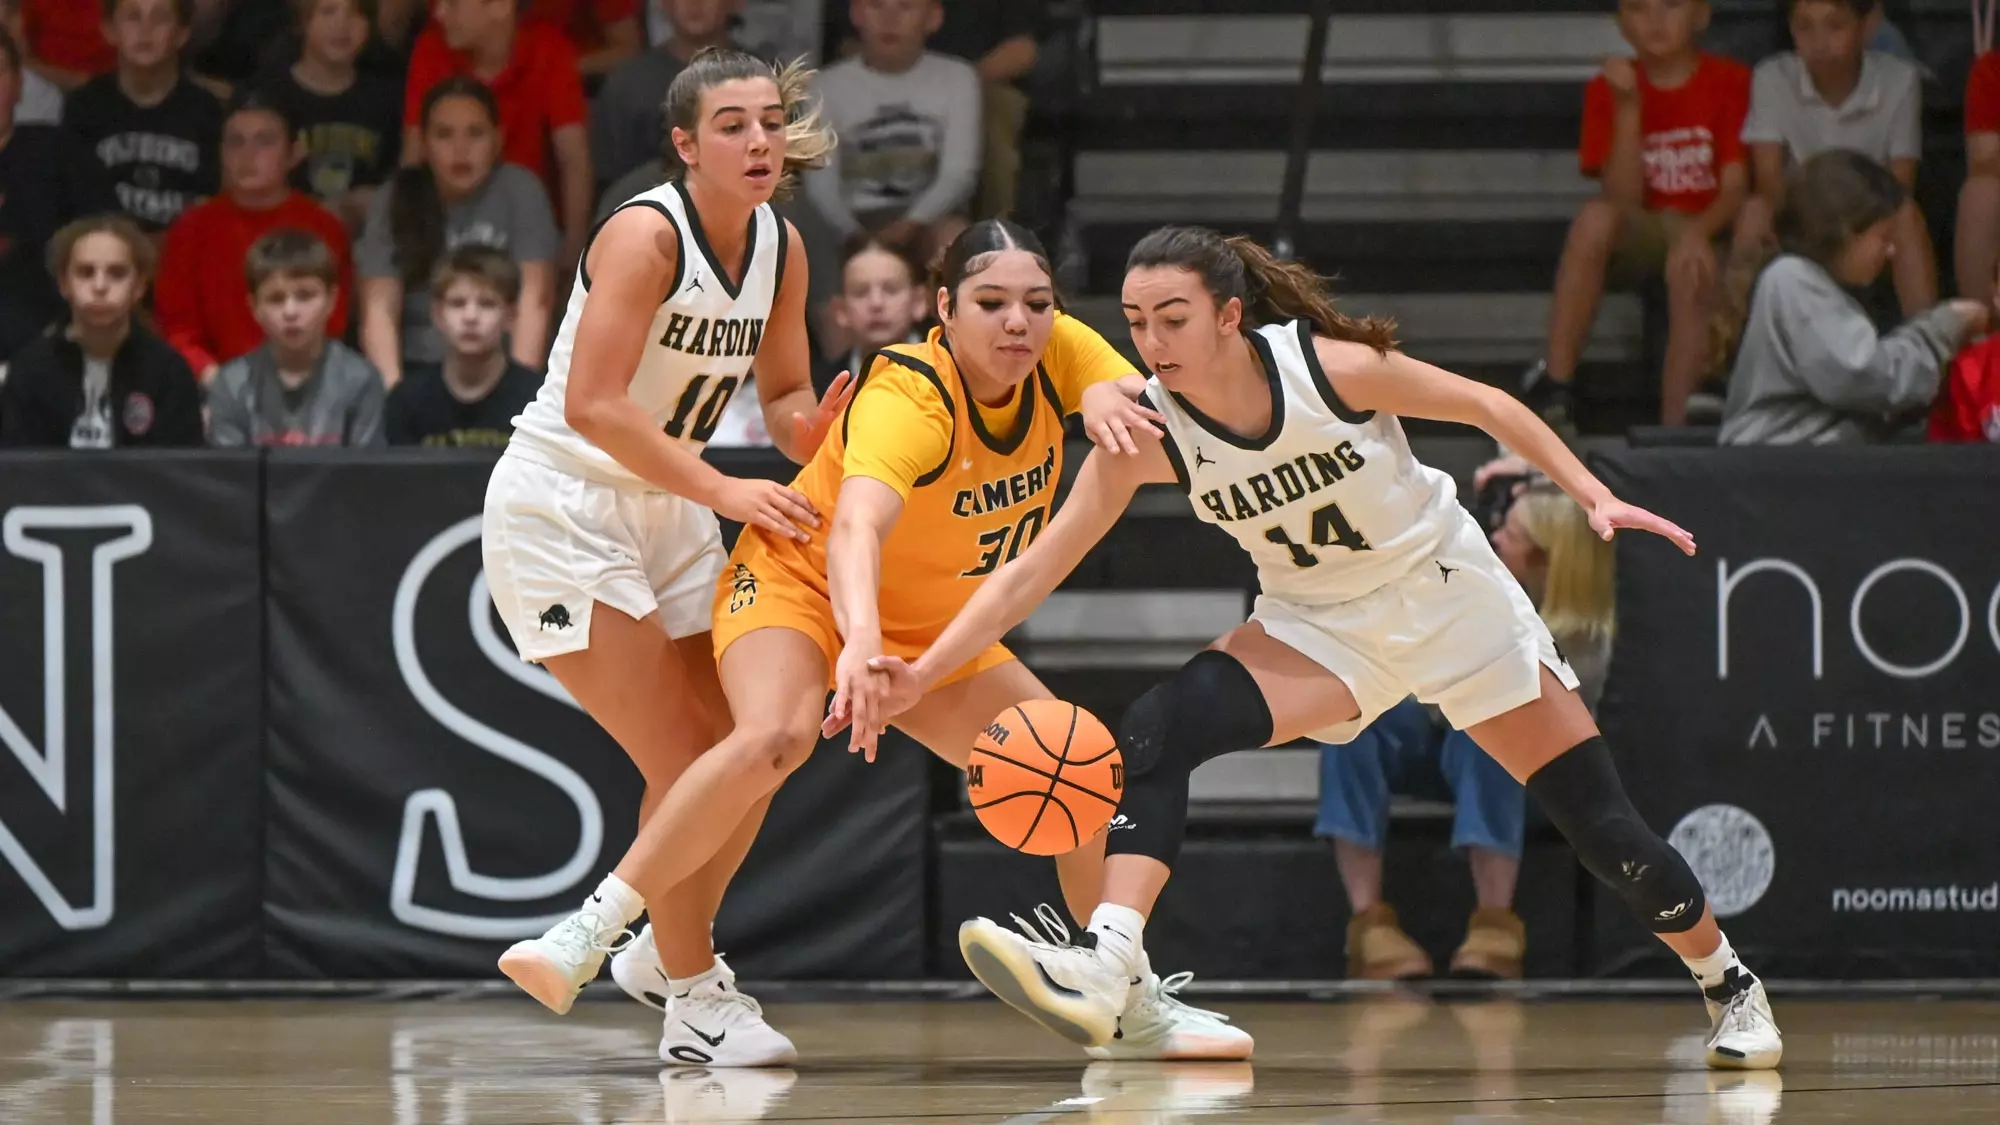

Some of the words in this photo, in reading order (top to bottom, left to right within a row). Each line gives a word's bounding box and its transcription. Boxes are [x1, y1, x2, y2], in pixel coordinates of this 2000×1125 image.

[664, 374, 738, 443] 10
[1200, 440, 1366, 522] HARDING
[960, 505, 1046, 577] 30
[1263, 501, 1375, 568] 14
[1717, 558, 2000, 680] no
[1812, 712, 2000, 750] FITNES
[1832, 880, 1998, 912] noomastud
